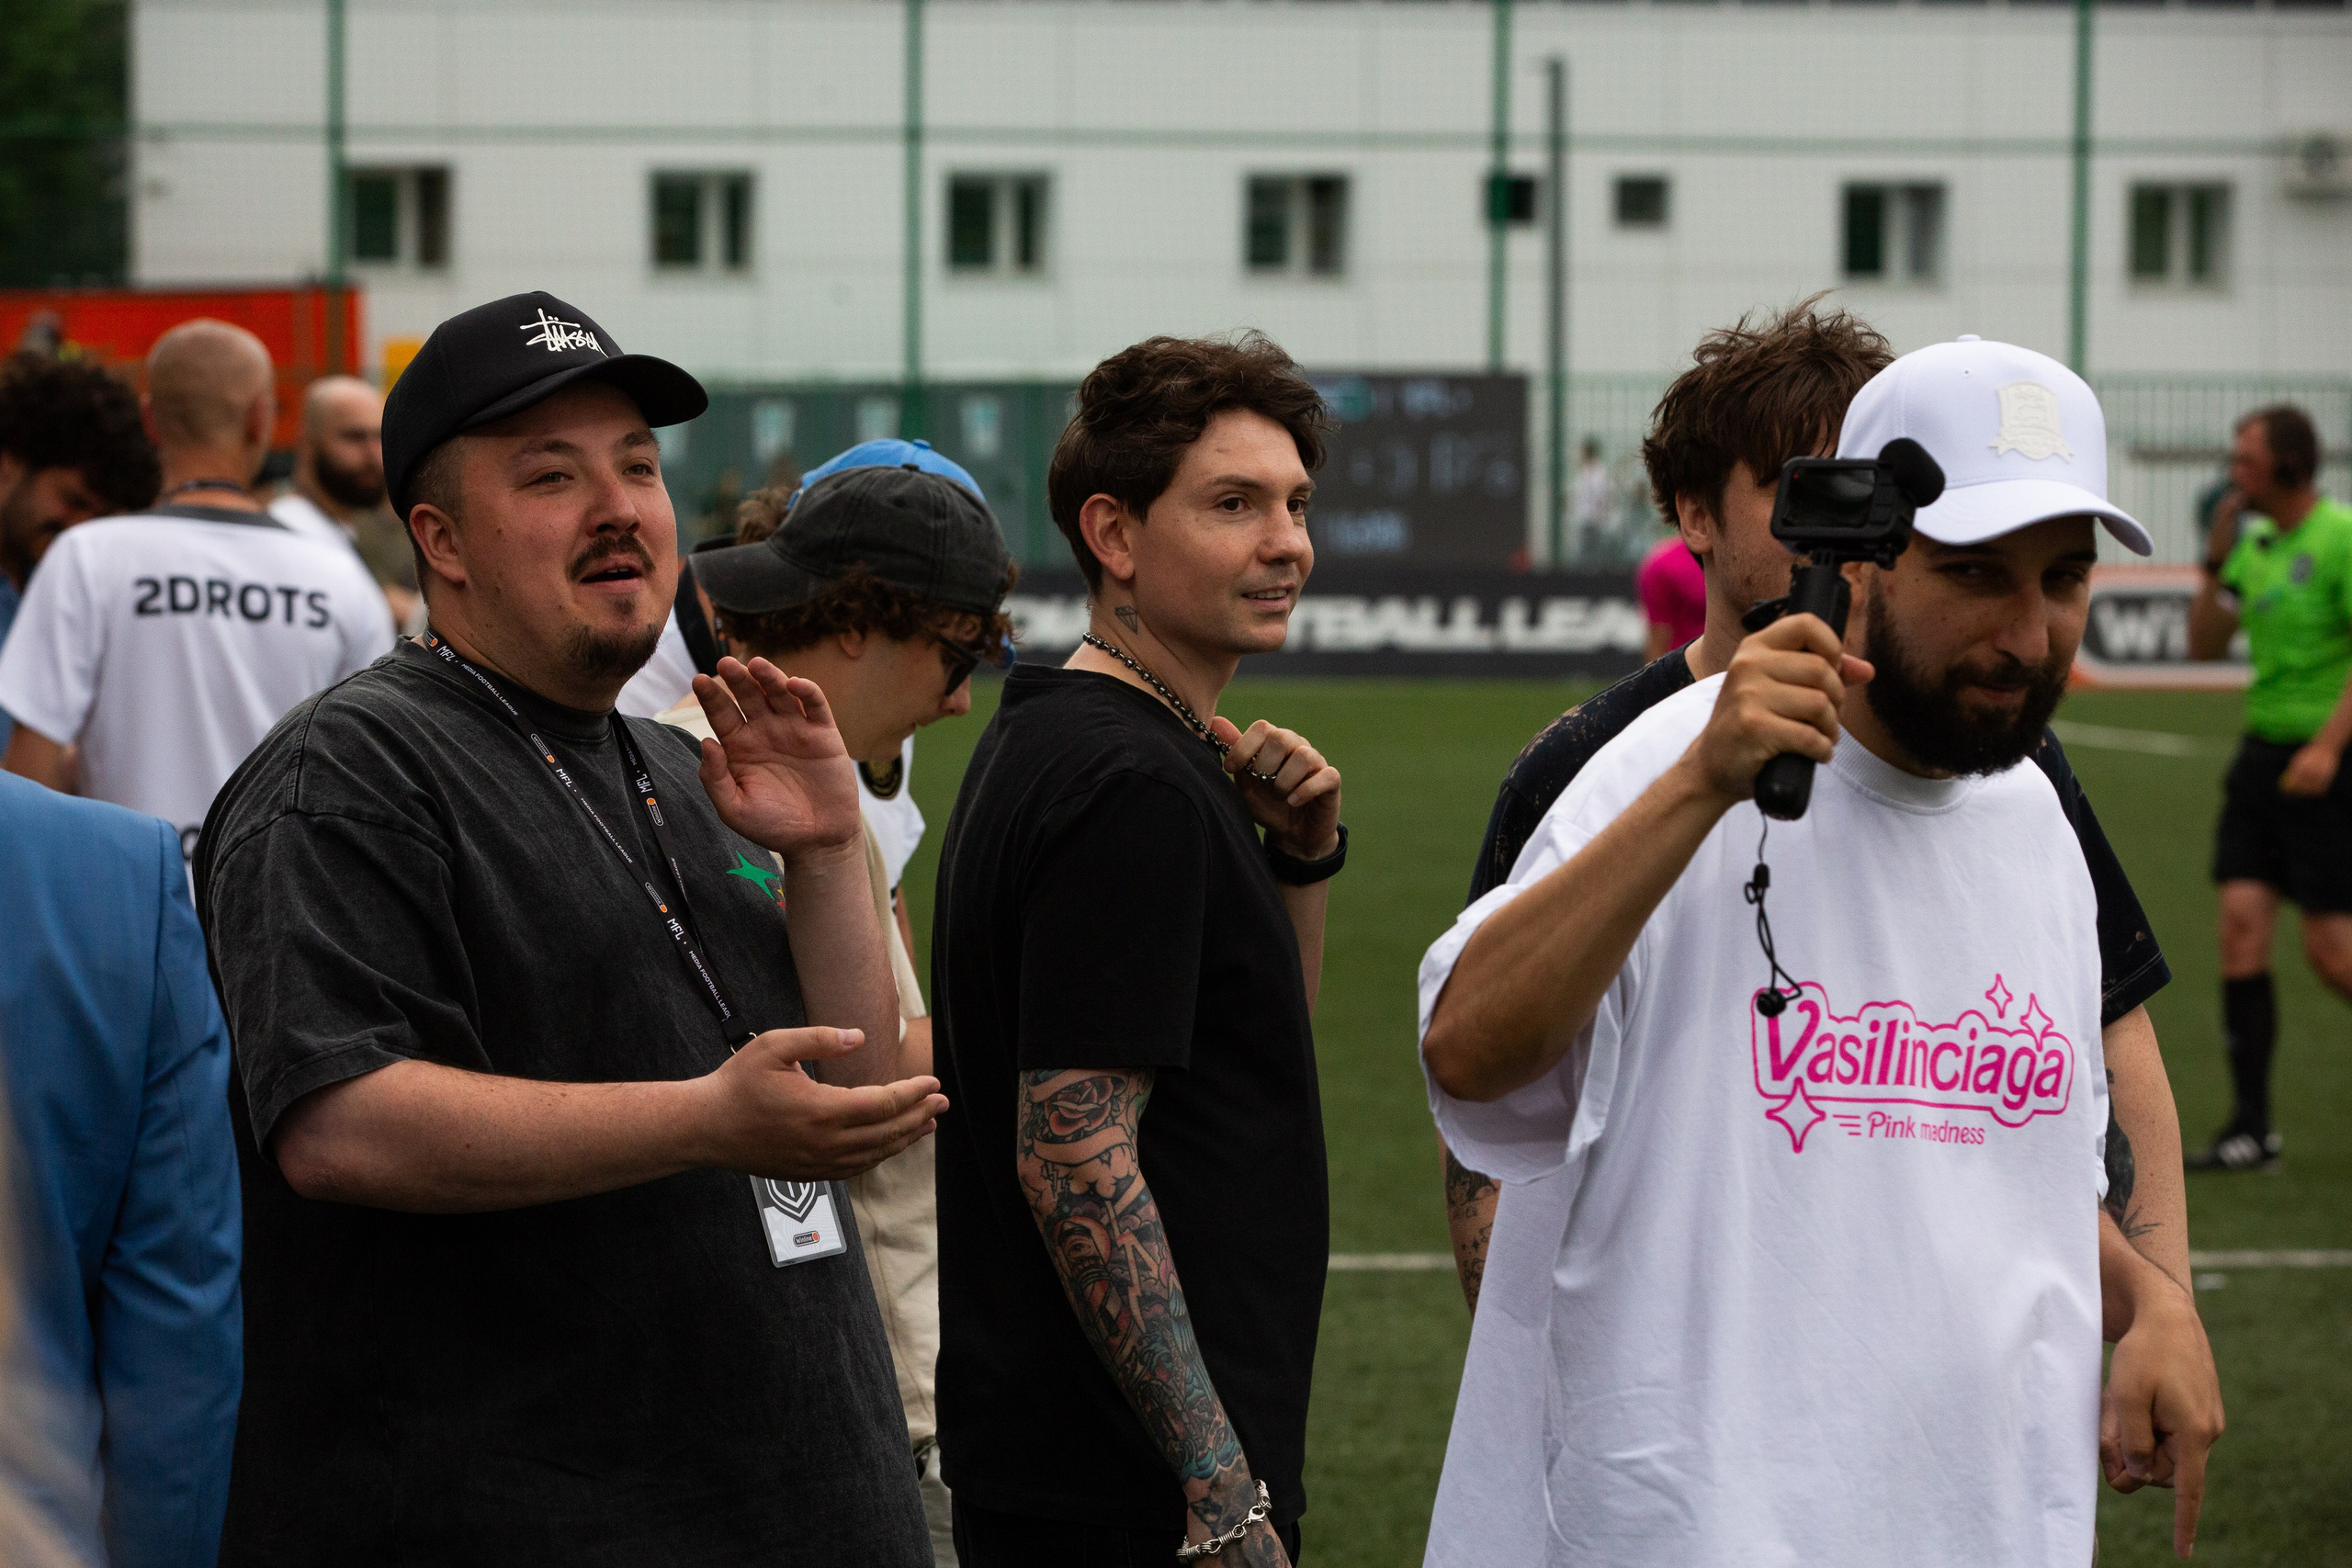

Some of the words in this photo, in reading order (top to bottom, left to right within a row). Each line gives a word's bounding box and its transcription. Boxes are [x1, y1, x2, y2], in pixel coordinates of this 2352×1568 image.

[135, 575, 331, 628] 2DROTS
[1287, 594, 1494, 651] TBALL
[1499, 594, 1648, 651] LEA
[436, 645, 456, 662] MFL
[461, 663, 477, 676] MEDIA
[475, 672, 500, 698] FOOTBALL
[499, 695, 518, 716] LEAGUE
[556, 768, 572, 787] MFL
[636, 773, 652, 793] MFL
[581, 797, 594, 815] MEDIA
[594, 814, 616, 843] FOOTBALL
[615, 841, 633, 863] LEAGUE
[667, 918, 684, 941] MFL
[689, 950, 702, 970] MEDIA
[699, 968, 720, 1001] FOOTBALL
[1767, 998, 2065, 1111] Vasilinciaga
[1866, 1111, 1916, 1139] Pink
[1919, 1119, 1985, 1145] madness
